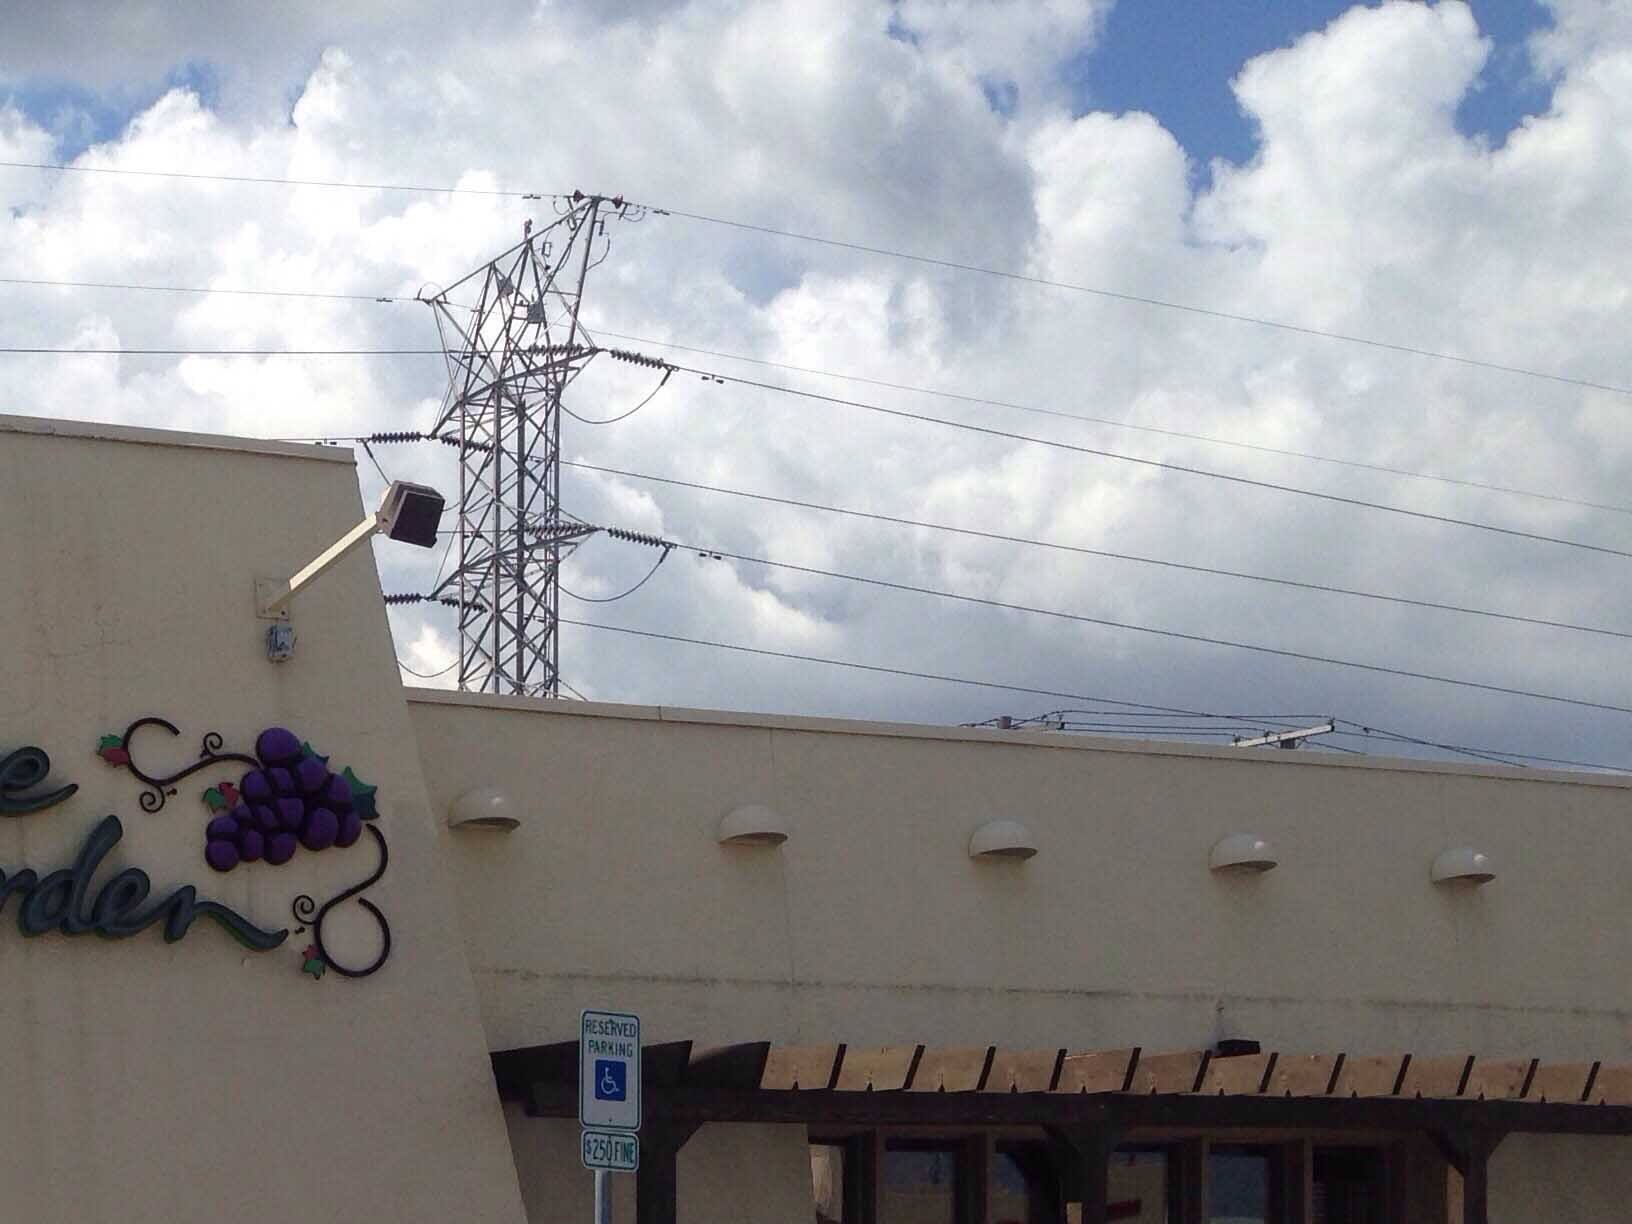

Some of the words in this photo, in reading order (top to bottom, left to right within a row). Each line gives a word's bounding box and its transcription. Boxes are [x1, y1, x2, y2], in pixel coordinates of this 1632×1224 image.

[585, 1019, 637, 1038] RESERVED
[588, 1039, 633, 1058] PARKING
[586, 1138, 612, 1162] $250
[614, 1141, 635, 1164] FINE
